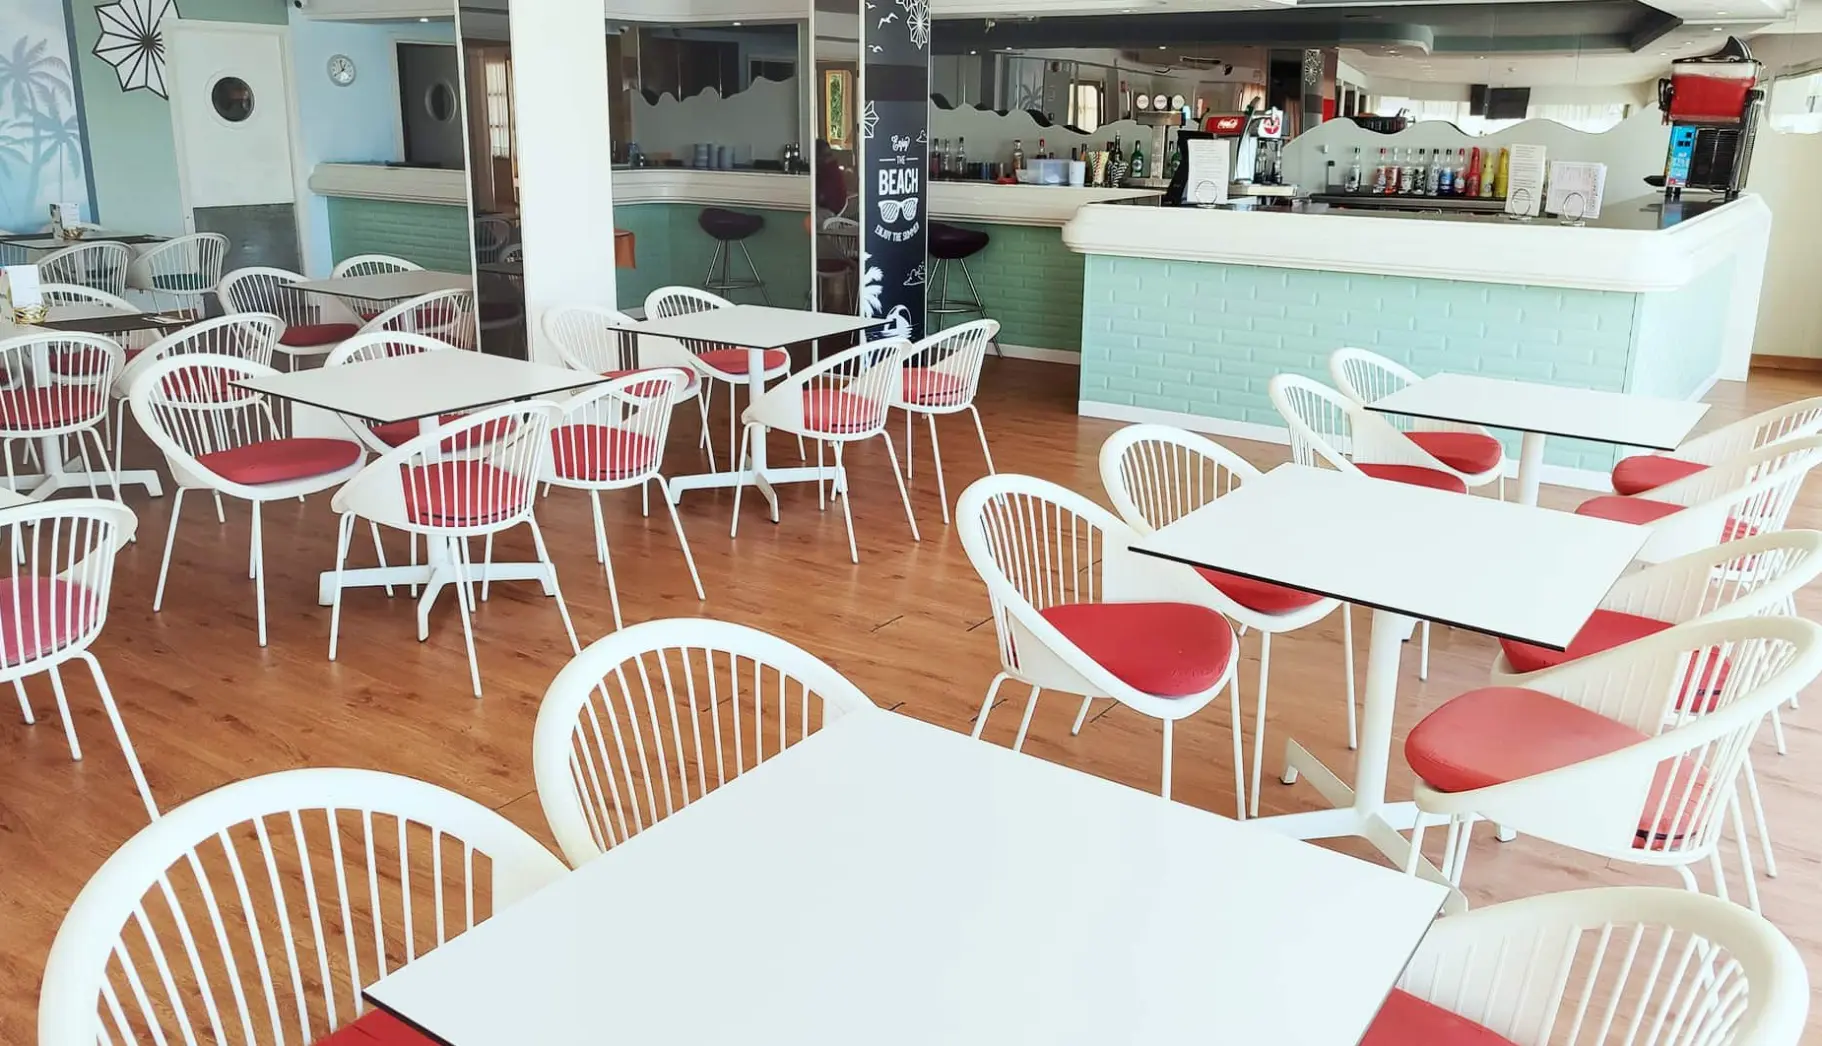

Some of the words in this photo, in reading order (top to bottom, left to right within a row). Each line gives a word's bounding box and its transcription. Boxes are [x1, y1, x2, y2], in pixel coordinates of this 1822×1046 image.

[896, 155, 906, 165] THE
[878, 168, 918, 196] BEACH
[892, 231, 902, 242] THE
